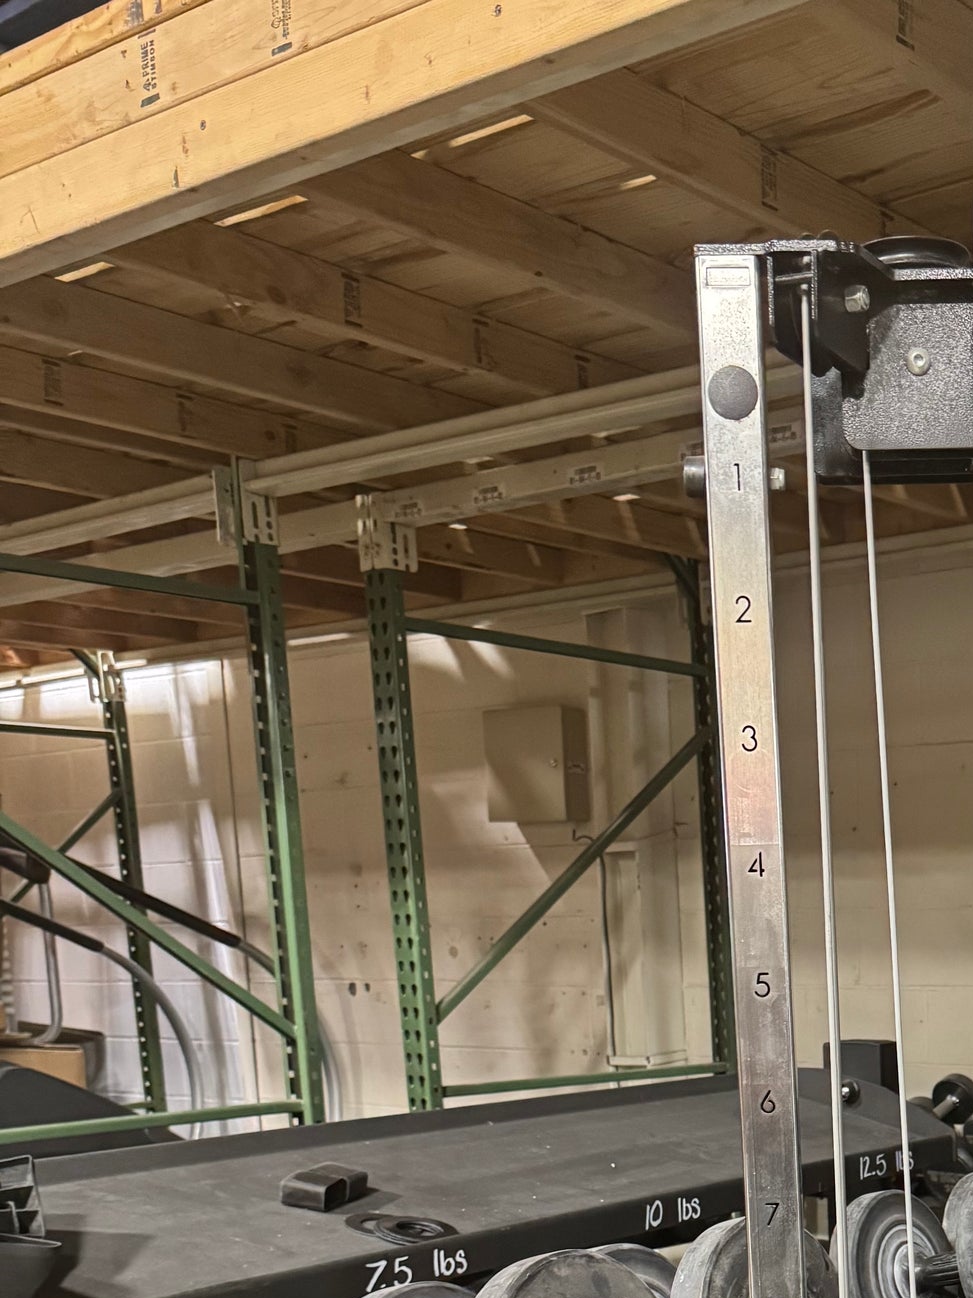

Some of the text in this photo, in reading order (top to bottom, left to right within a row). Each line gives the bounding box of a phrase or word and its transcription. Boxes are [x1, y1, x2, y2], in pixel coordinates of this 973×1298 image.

[140, 41, 150, 77] PRIME
[733, 463, 741, 491] 1
[735, 595, 752, 623] 2
[741, 725, 758, 752] 3
[747, 851, 766, 878] 4
[754, 972, 771, 998] 5
[760, 1090, 776, 1114] 6
[860, 1153, 887, 1180] 12.5
[645, 1197, 701, 1231] 10 lbs
[764, 1201, 780, 1227] 7
[365, 1248, 468, 1293] 7.5 lbs
